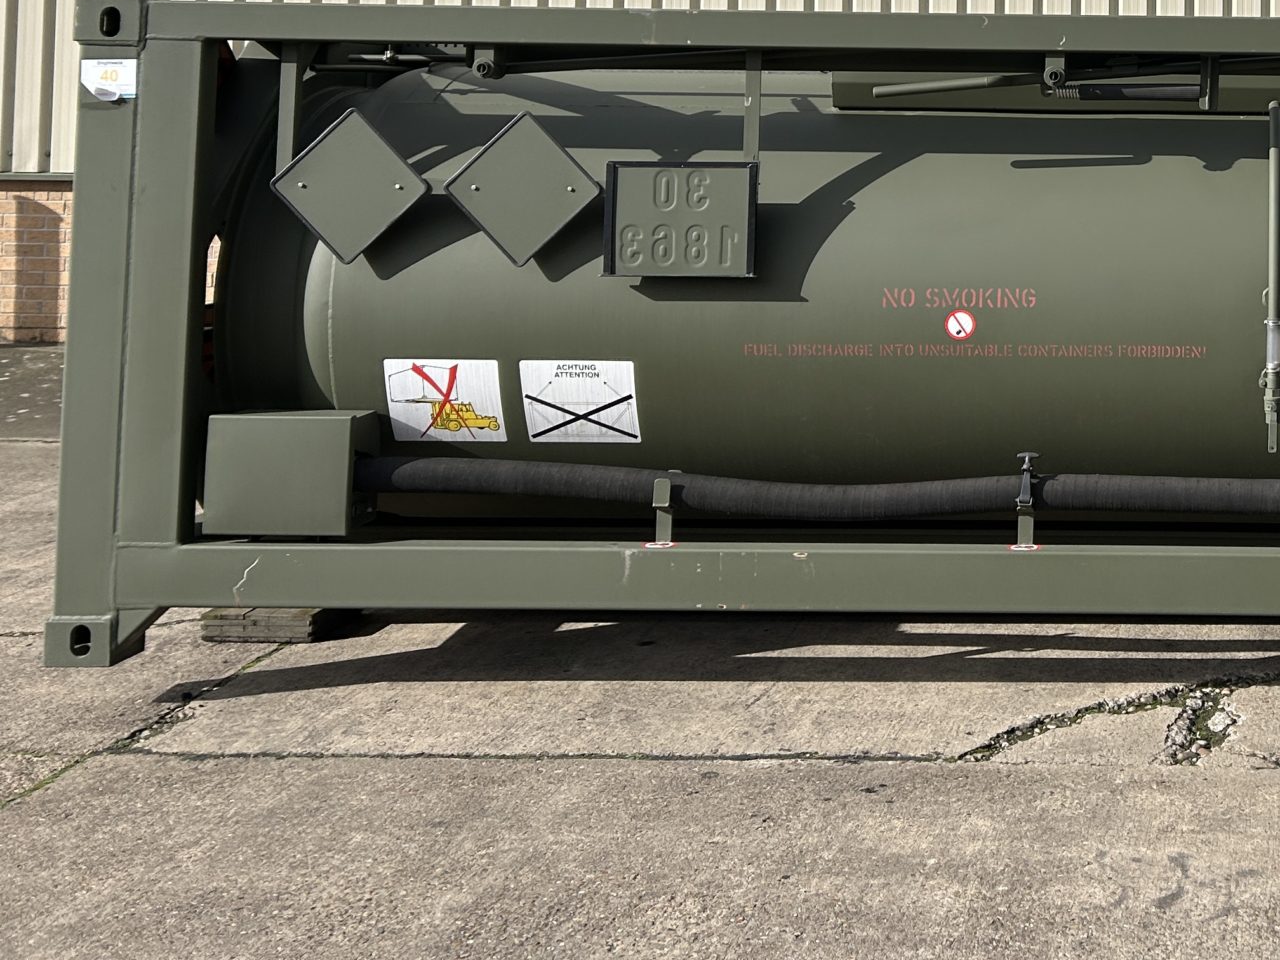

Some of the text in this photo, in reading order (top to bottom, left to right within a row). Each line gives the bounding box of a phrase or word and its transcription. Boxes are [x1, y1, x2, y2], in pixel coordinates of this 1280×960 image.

[882, 287, 1037, 309] NO SMOKING
[743, 344, 781, 356] FUEL
[787, 344, 873, 356] DISCHARGE
[879, 344, 915, 356] INTO
[919, 344, 1013, 357] UNSUITABLE
[1018, 344, 1113, 358] CONTAINERS
[554, 371, 600, 379] ATTENTION
